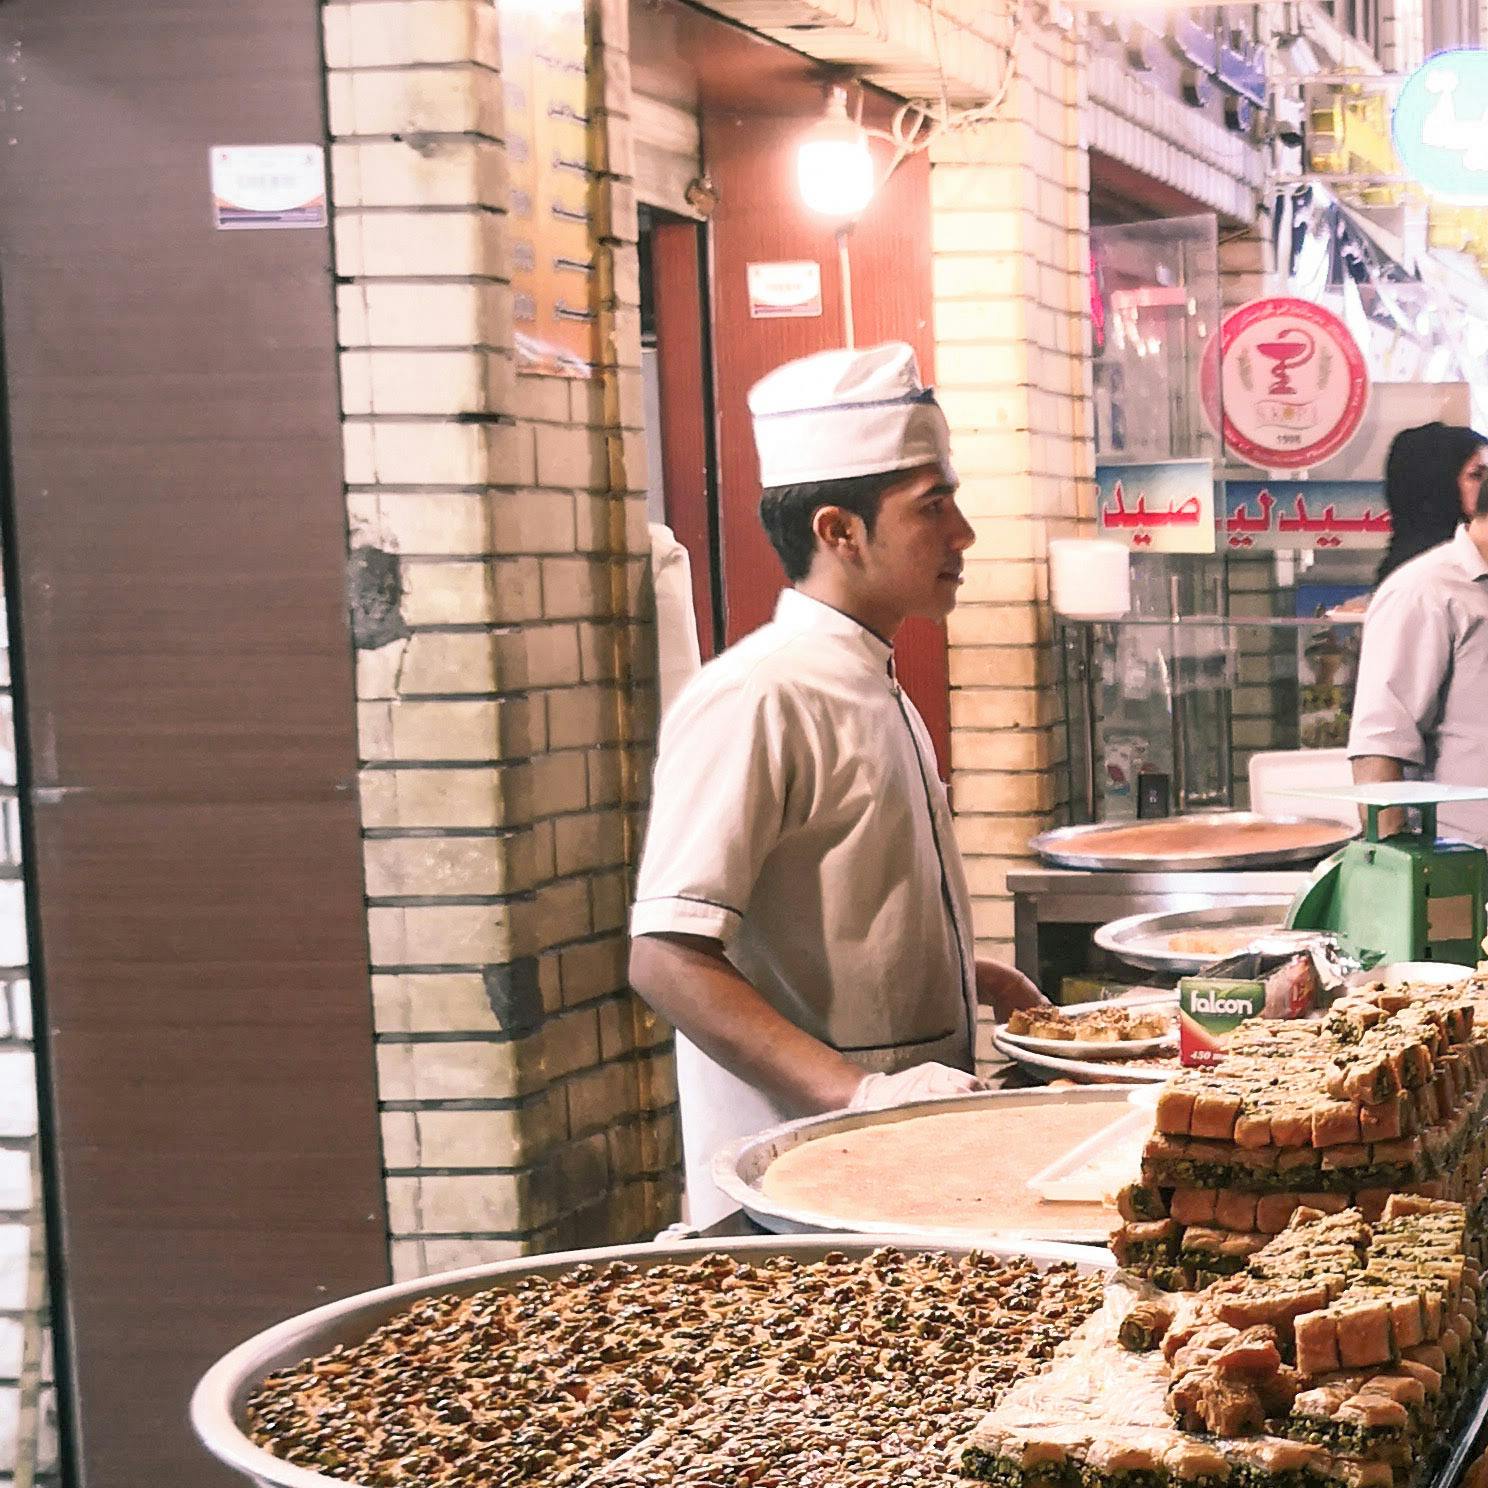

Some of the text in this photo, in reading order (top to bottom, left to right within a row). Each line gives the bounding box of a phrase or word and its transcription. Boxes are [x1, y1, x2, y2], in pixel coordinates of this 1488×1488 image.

[1099, 479, 1201, 546] صيد
[1215, 489, 1393, 547] صيدلي
[1190, 989, 1253, 1014] falcon
